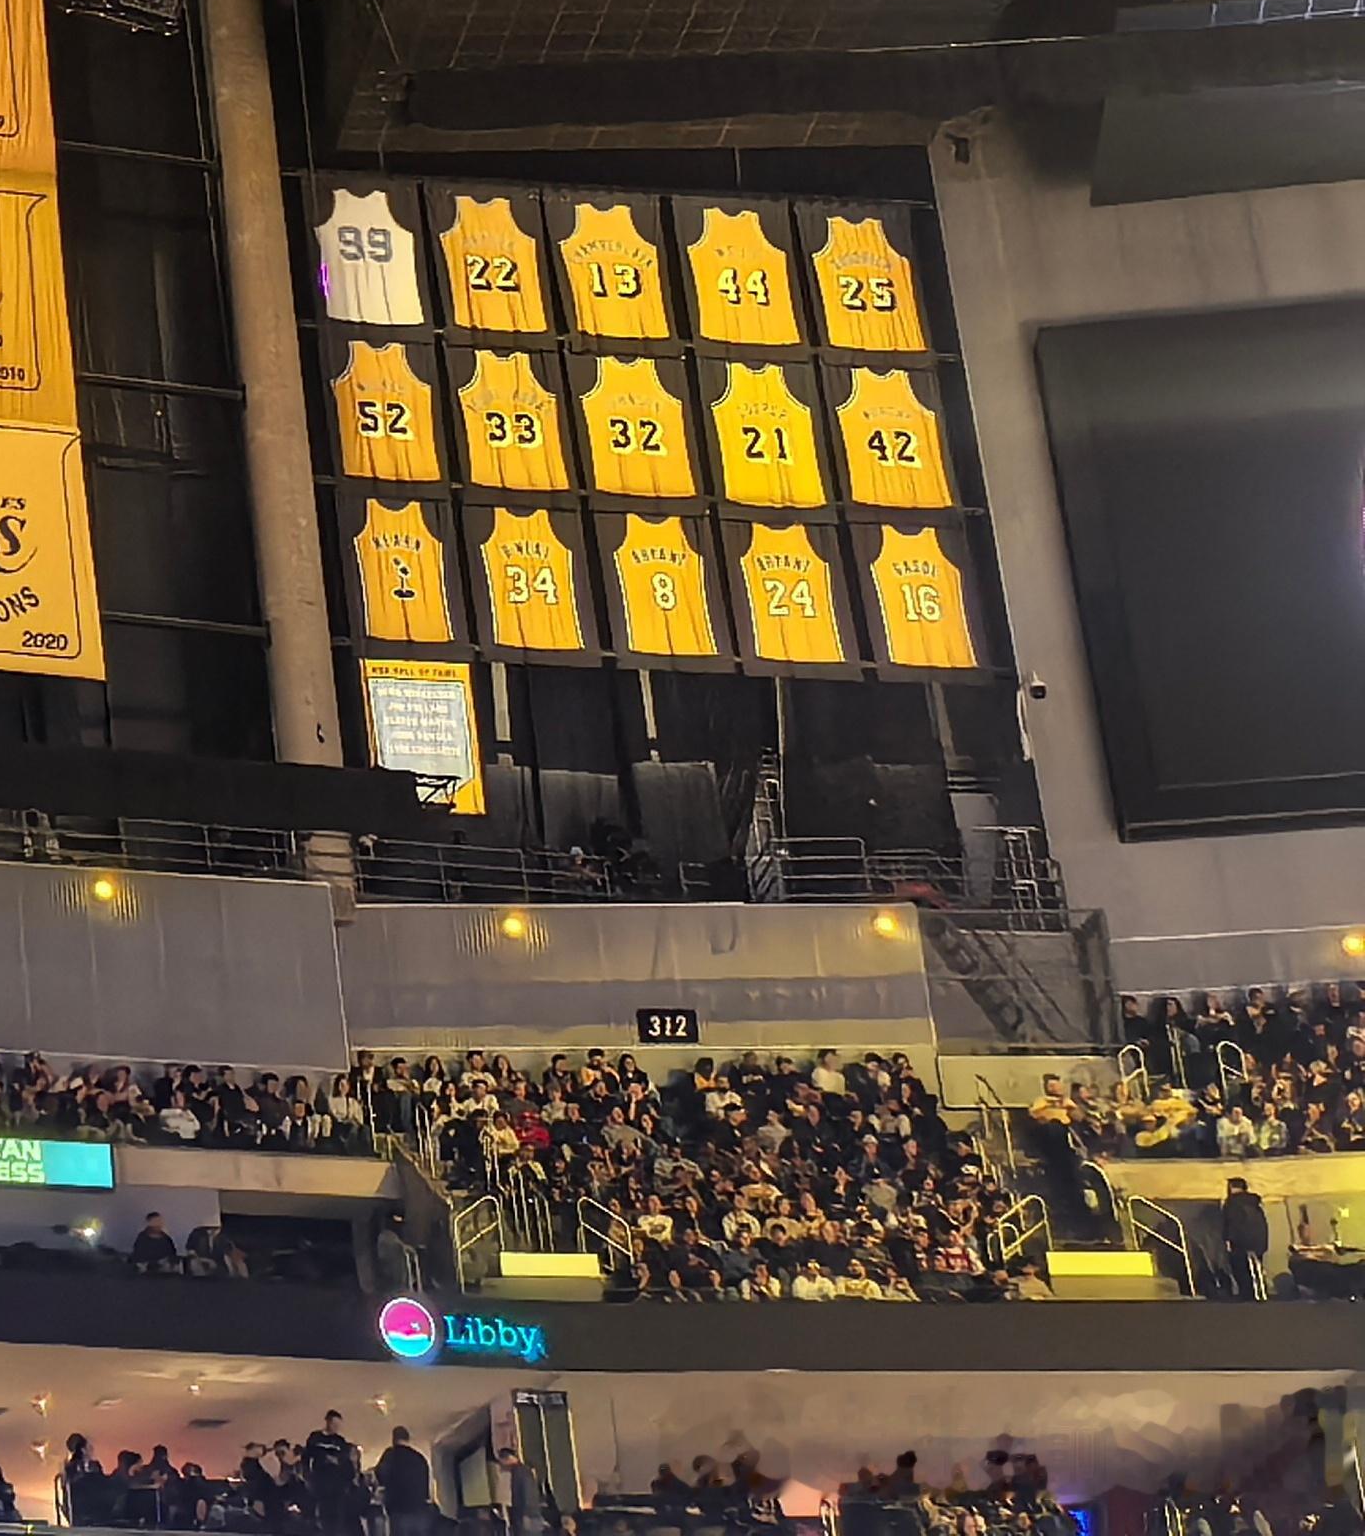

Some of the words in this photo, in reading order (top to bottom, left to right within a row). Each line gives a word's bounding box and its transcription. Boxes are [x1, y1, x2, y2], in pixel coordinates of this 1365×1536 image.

[338, 226, 392, 262] 99
[467, 255, 519, 291] 22
[589, 262, 642, 298] 13
[717, 268, 769, 305] 44
[838, 275, 896, 311] 25
[358, 400, 414, 441] 52
[485, 412, 542, 447] 33
[610, 418, 667, 456] 32
[742, 426, 793, 464] 21
[868, 430, 921, 469] 42
[505, 564, 557, 604] 34
[650, 571, 677, 610] 8
[763, 578, 816, 617] 24
[901, 582, 941, 621] 16
[22, 630, 69, 650] 2020
[648, 1014, 688, 1038] 312
